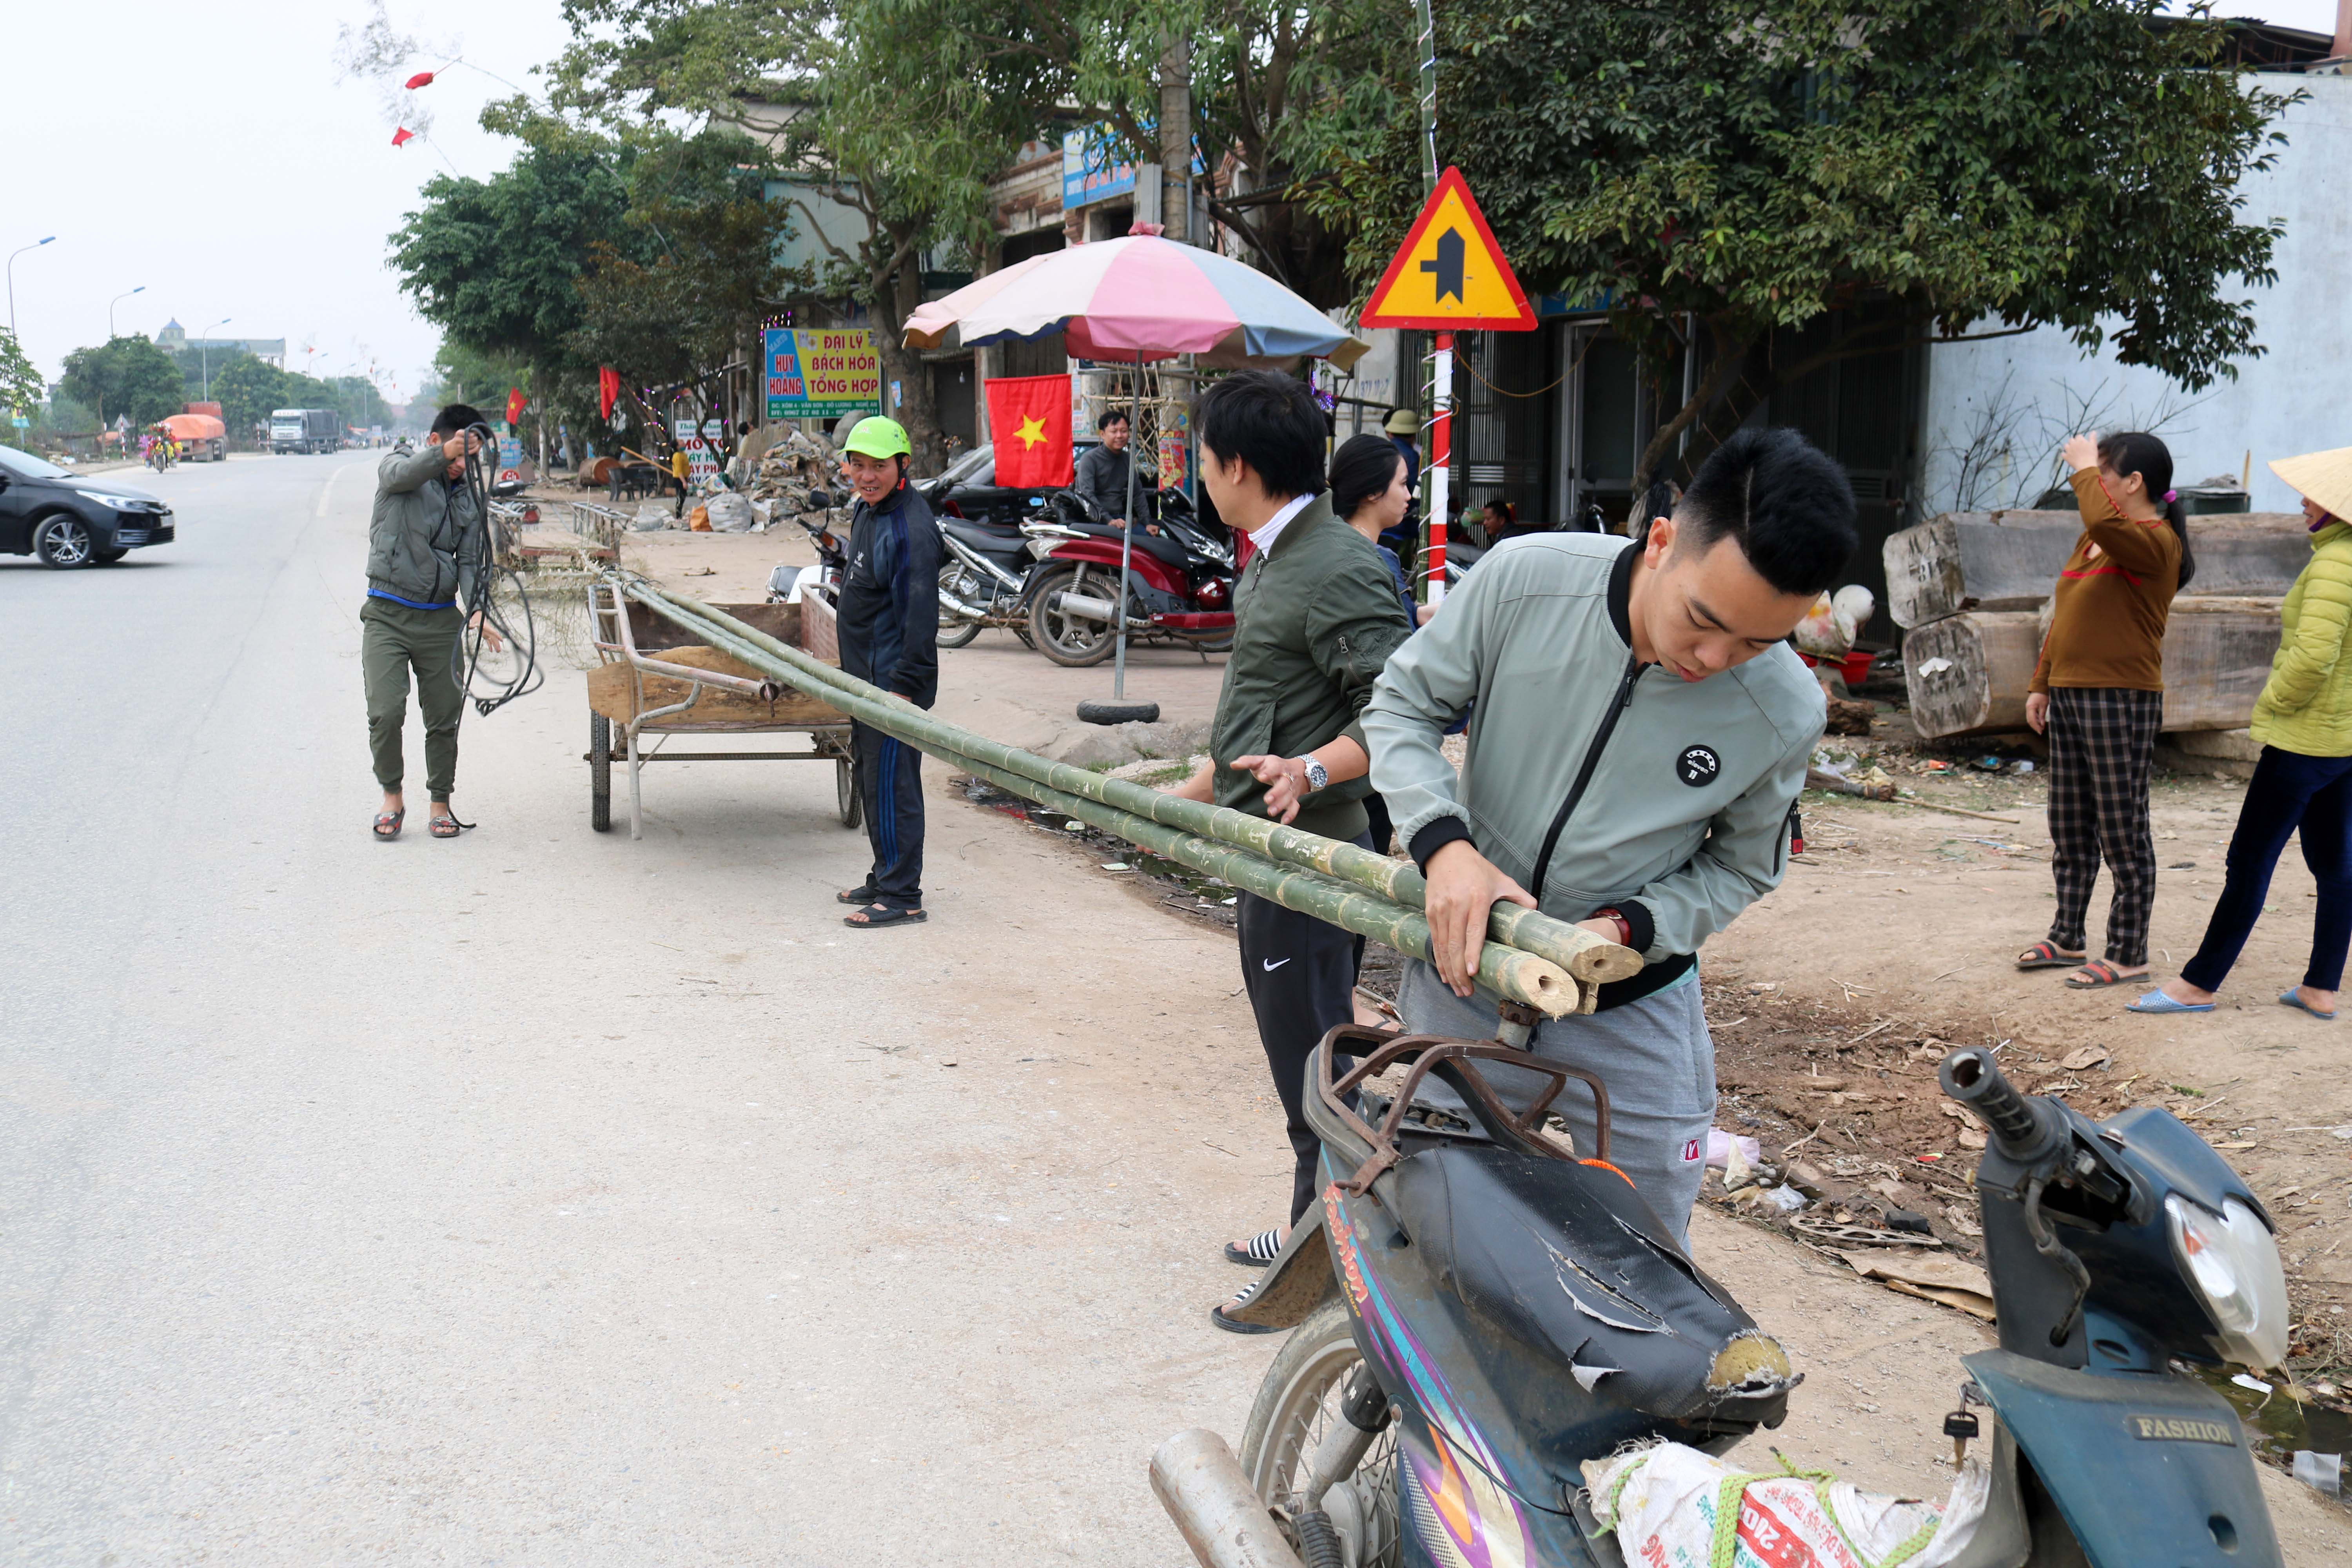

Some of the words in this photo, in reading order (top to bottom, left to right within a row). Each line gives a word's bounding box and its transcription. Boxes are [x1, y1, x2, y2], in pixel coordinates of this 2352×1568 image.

[824, 335, 845, 353] ĐẠI
[850, 332, 863, 349] LÝ
[775, 354, 794, 372] HUY
[812, 353, 844, 370] BÁCH
[848, 353, 875, 370] HÓA
[810, 373, 848, 393] TỔNG
[851, 379, 878, 397] HỢP
[1687, 759, 1709, 774] eleven
[1343, 1281, 1361, 1318] Deluxe
[2136, 1418, 2233, 1444] FASHION
